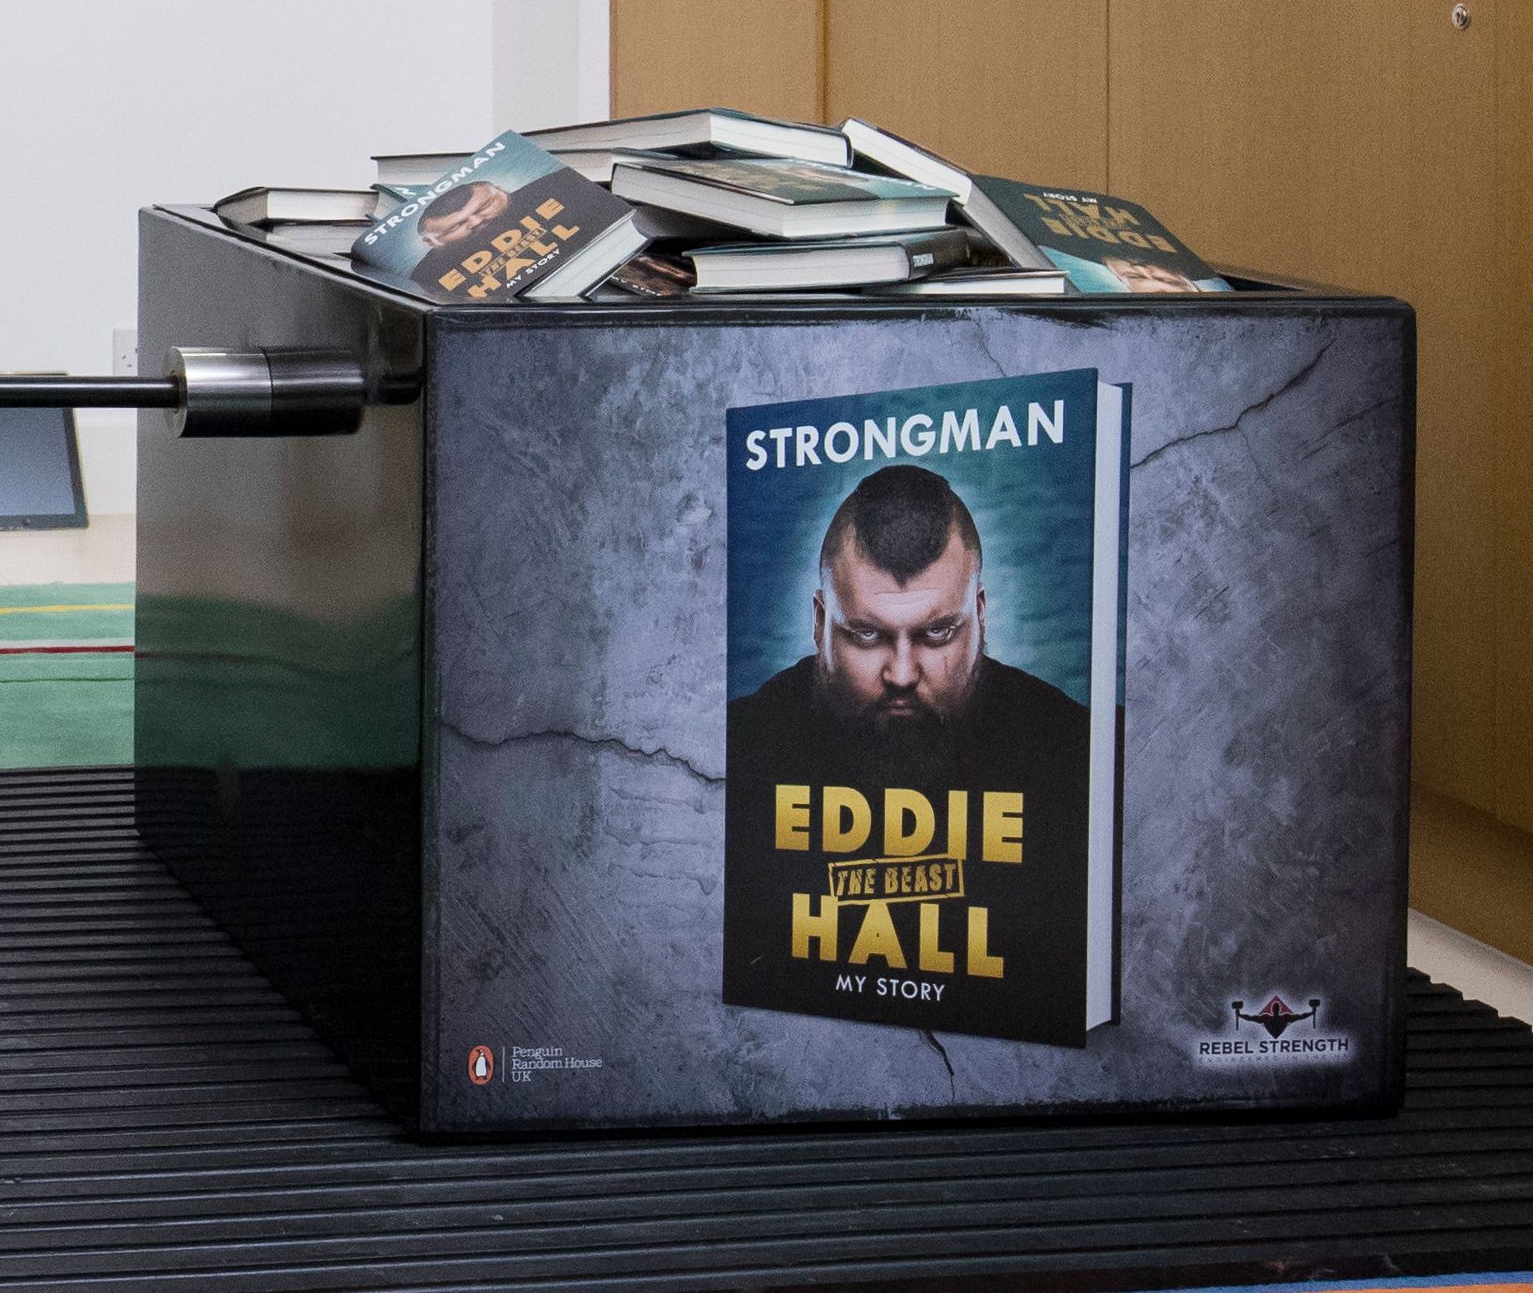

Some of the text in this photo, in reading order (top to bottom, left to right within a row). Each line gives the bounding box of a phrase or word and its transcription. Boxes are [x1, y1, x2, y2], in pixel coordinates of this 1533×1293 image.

[364, 141, 506, 245] STRONGMAN
[438, 197, 565, 291] EDDIE
[467, 224, 580, 298] HALL
[744, 399, 1065, 472] STRONGMAN
[775, 784, 1024, 864] EDDIE
[836, 863, 957, 897] THE BEAST
[791, 892, 1004, 979] HALL
[835, 974, 946, 1002] MY STORY
[511, 1057, 603, 1070] Random House
[512, 1046, 563, 1059] Penguin
[1199, 1038, 1349, 1055] REBEL STRENGTH
[512, 1071, 532, 1082] UK
